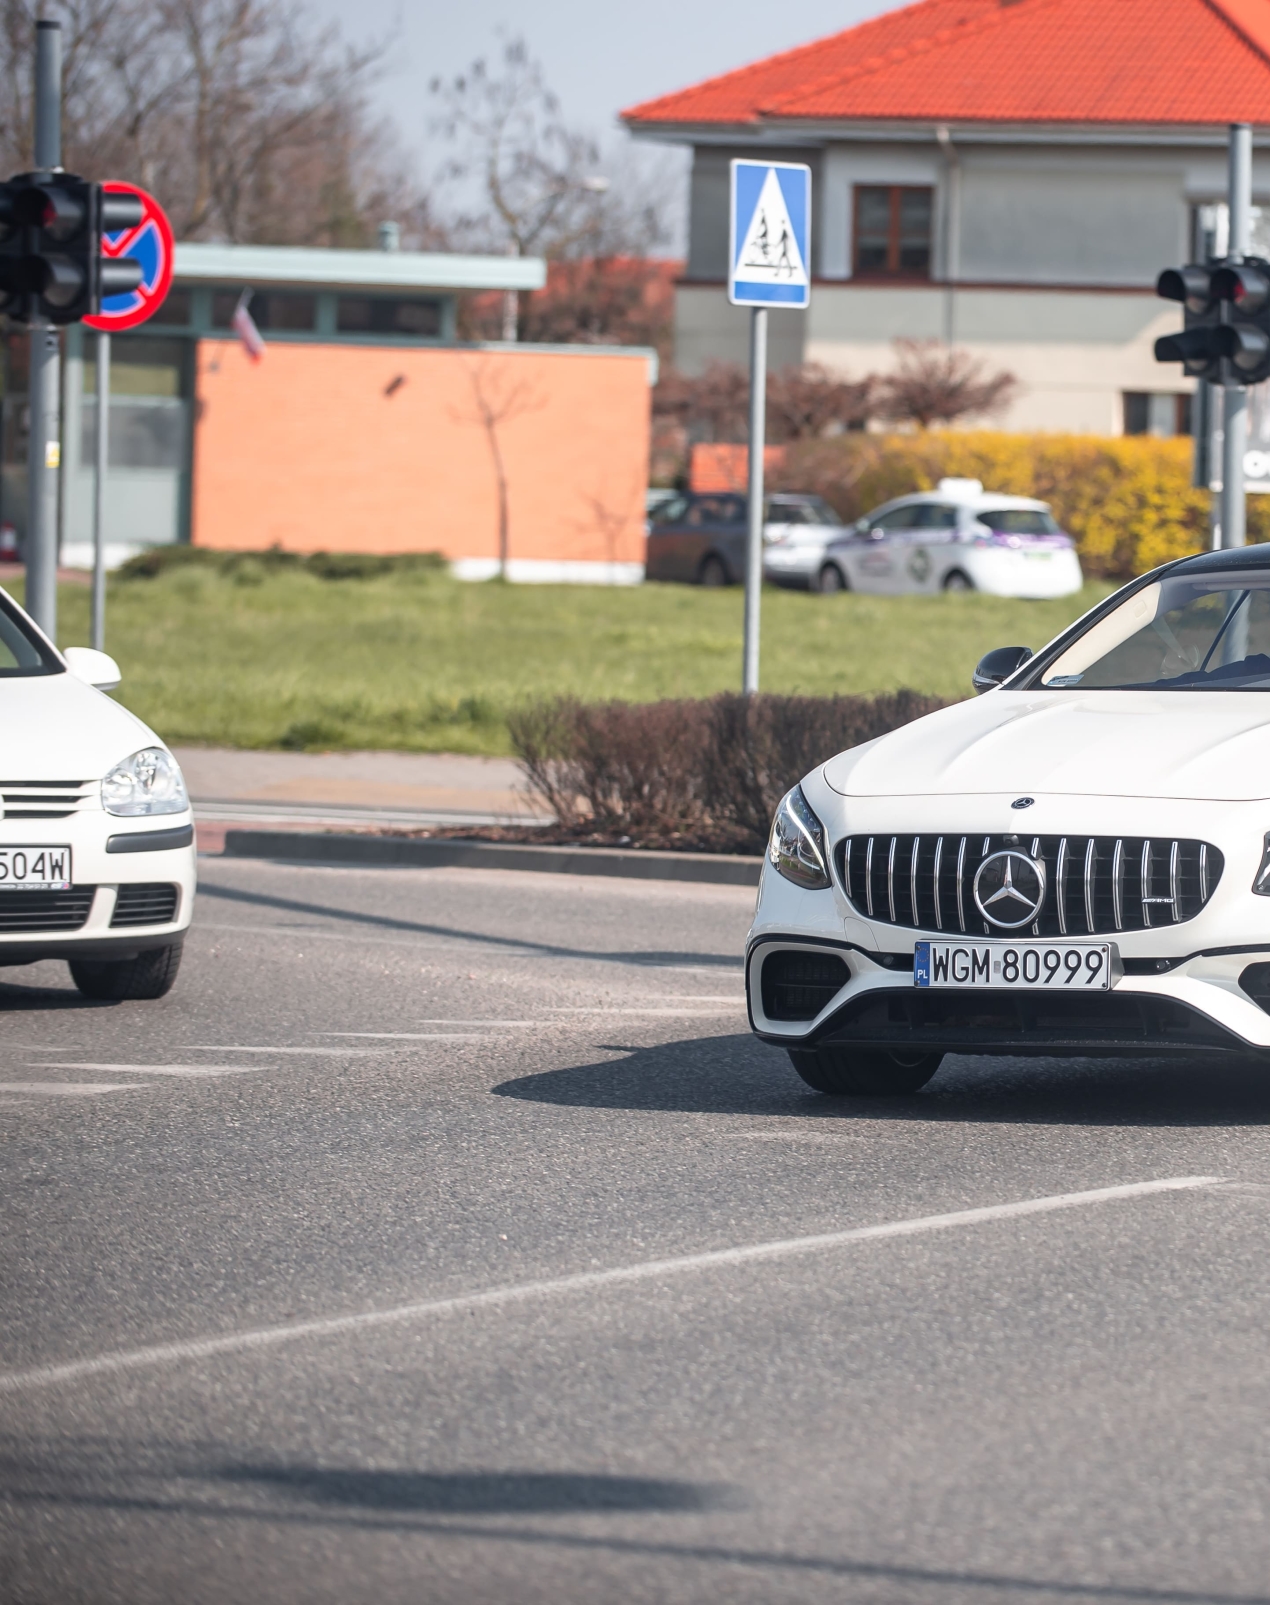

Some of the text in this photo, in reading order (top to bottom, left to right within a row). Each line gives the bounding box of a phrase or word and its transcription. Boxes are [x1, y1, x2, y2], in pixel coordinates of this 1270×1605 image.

[0, 852, 64, 880] 504W
[917, 969, 928, 979] PL
[932, 947, 1104, 984] WGM 80999
